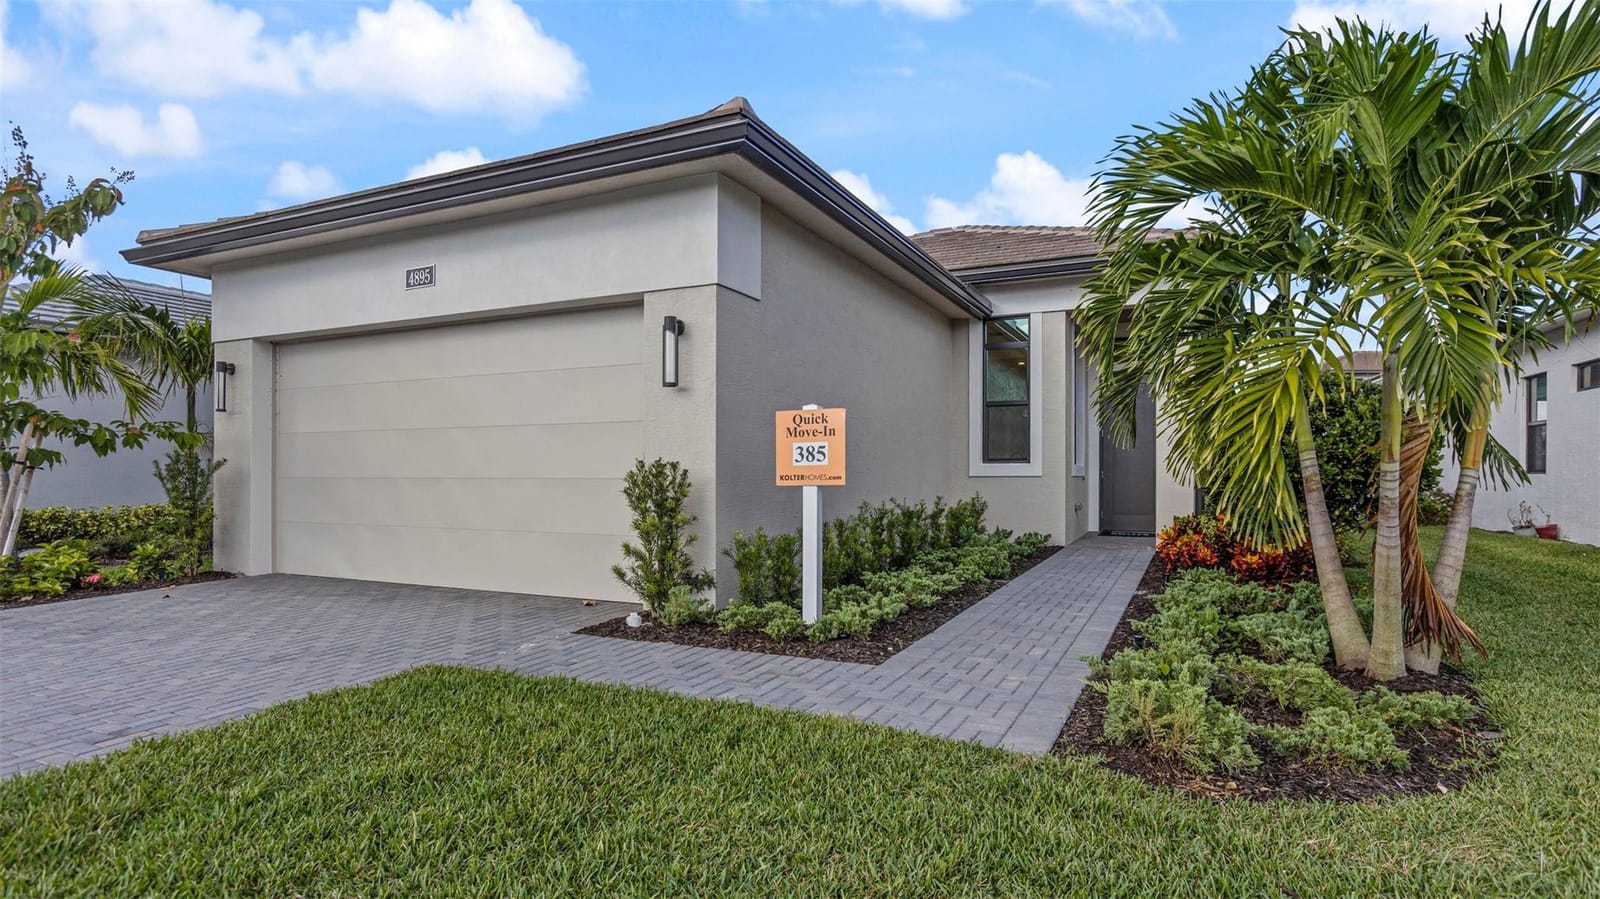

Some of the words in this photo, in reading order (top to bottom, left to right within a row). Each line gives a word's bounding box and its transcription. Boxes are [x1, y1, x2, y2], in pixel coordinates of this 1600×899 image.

[408, 269, 431, 286] 4895
[792, 413, 829, 427] Quick
[785, 425, 836, 438] Move-In
[794, 445, 826, 463] 385
